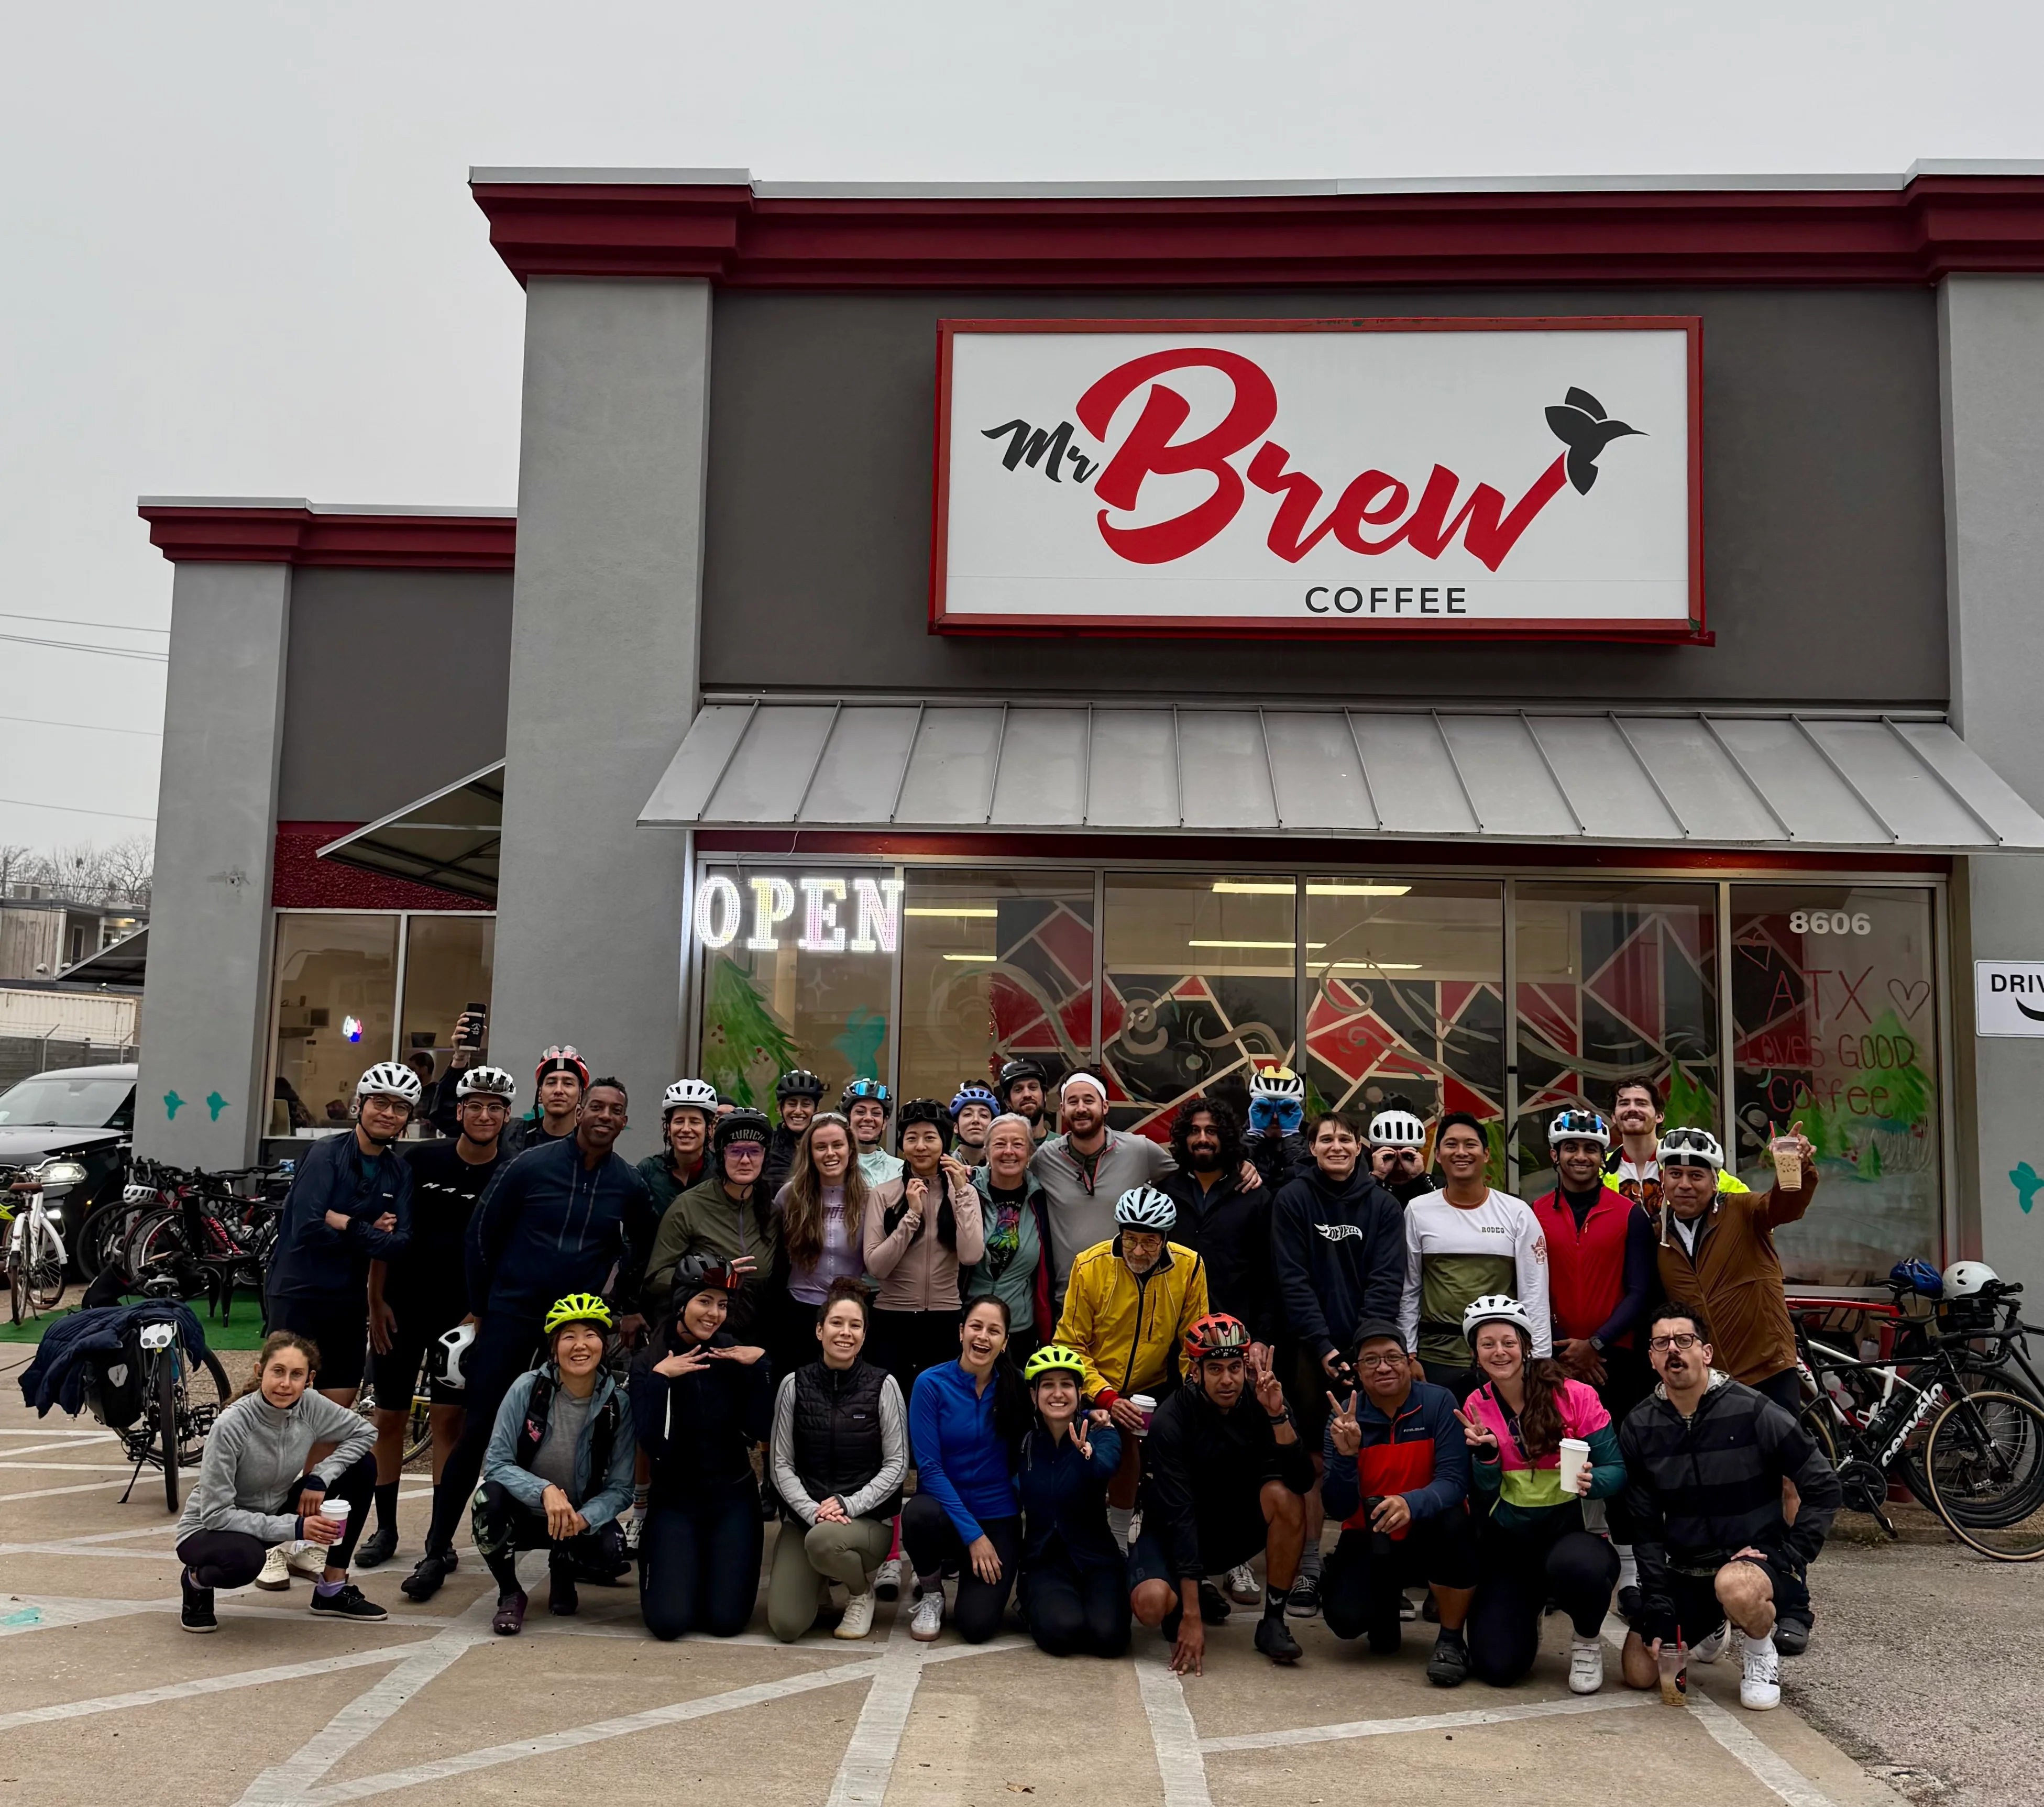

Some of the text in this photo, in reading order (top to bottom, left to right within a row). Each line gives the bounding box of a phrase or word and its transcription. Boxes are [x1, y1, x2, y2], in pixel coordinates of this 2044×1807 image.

[981, 347, 1567, 572] Mr Brew
[1305, 587, 1466, 613] COFFEE
[695, 876, 905, 951] OPEN
[1789, 911, 1871, 935] 8606
[1766, 965, 1874, 1024] ATX
[1838, 1033, 1915, 1070] GOOD
[729, 1129, 765, 1141] ZURICH
[1882, 1383, 1943, 1467] cervélo
